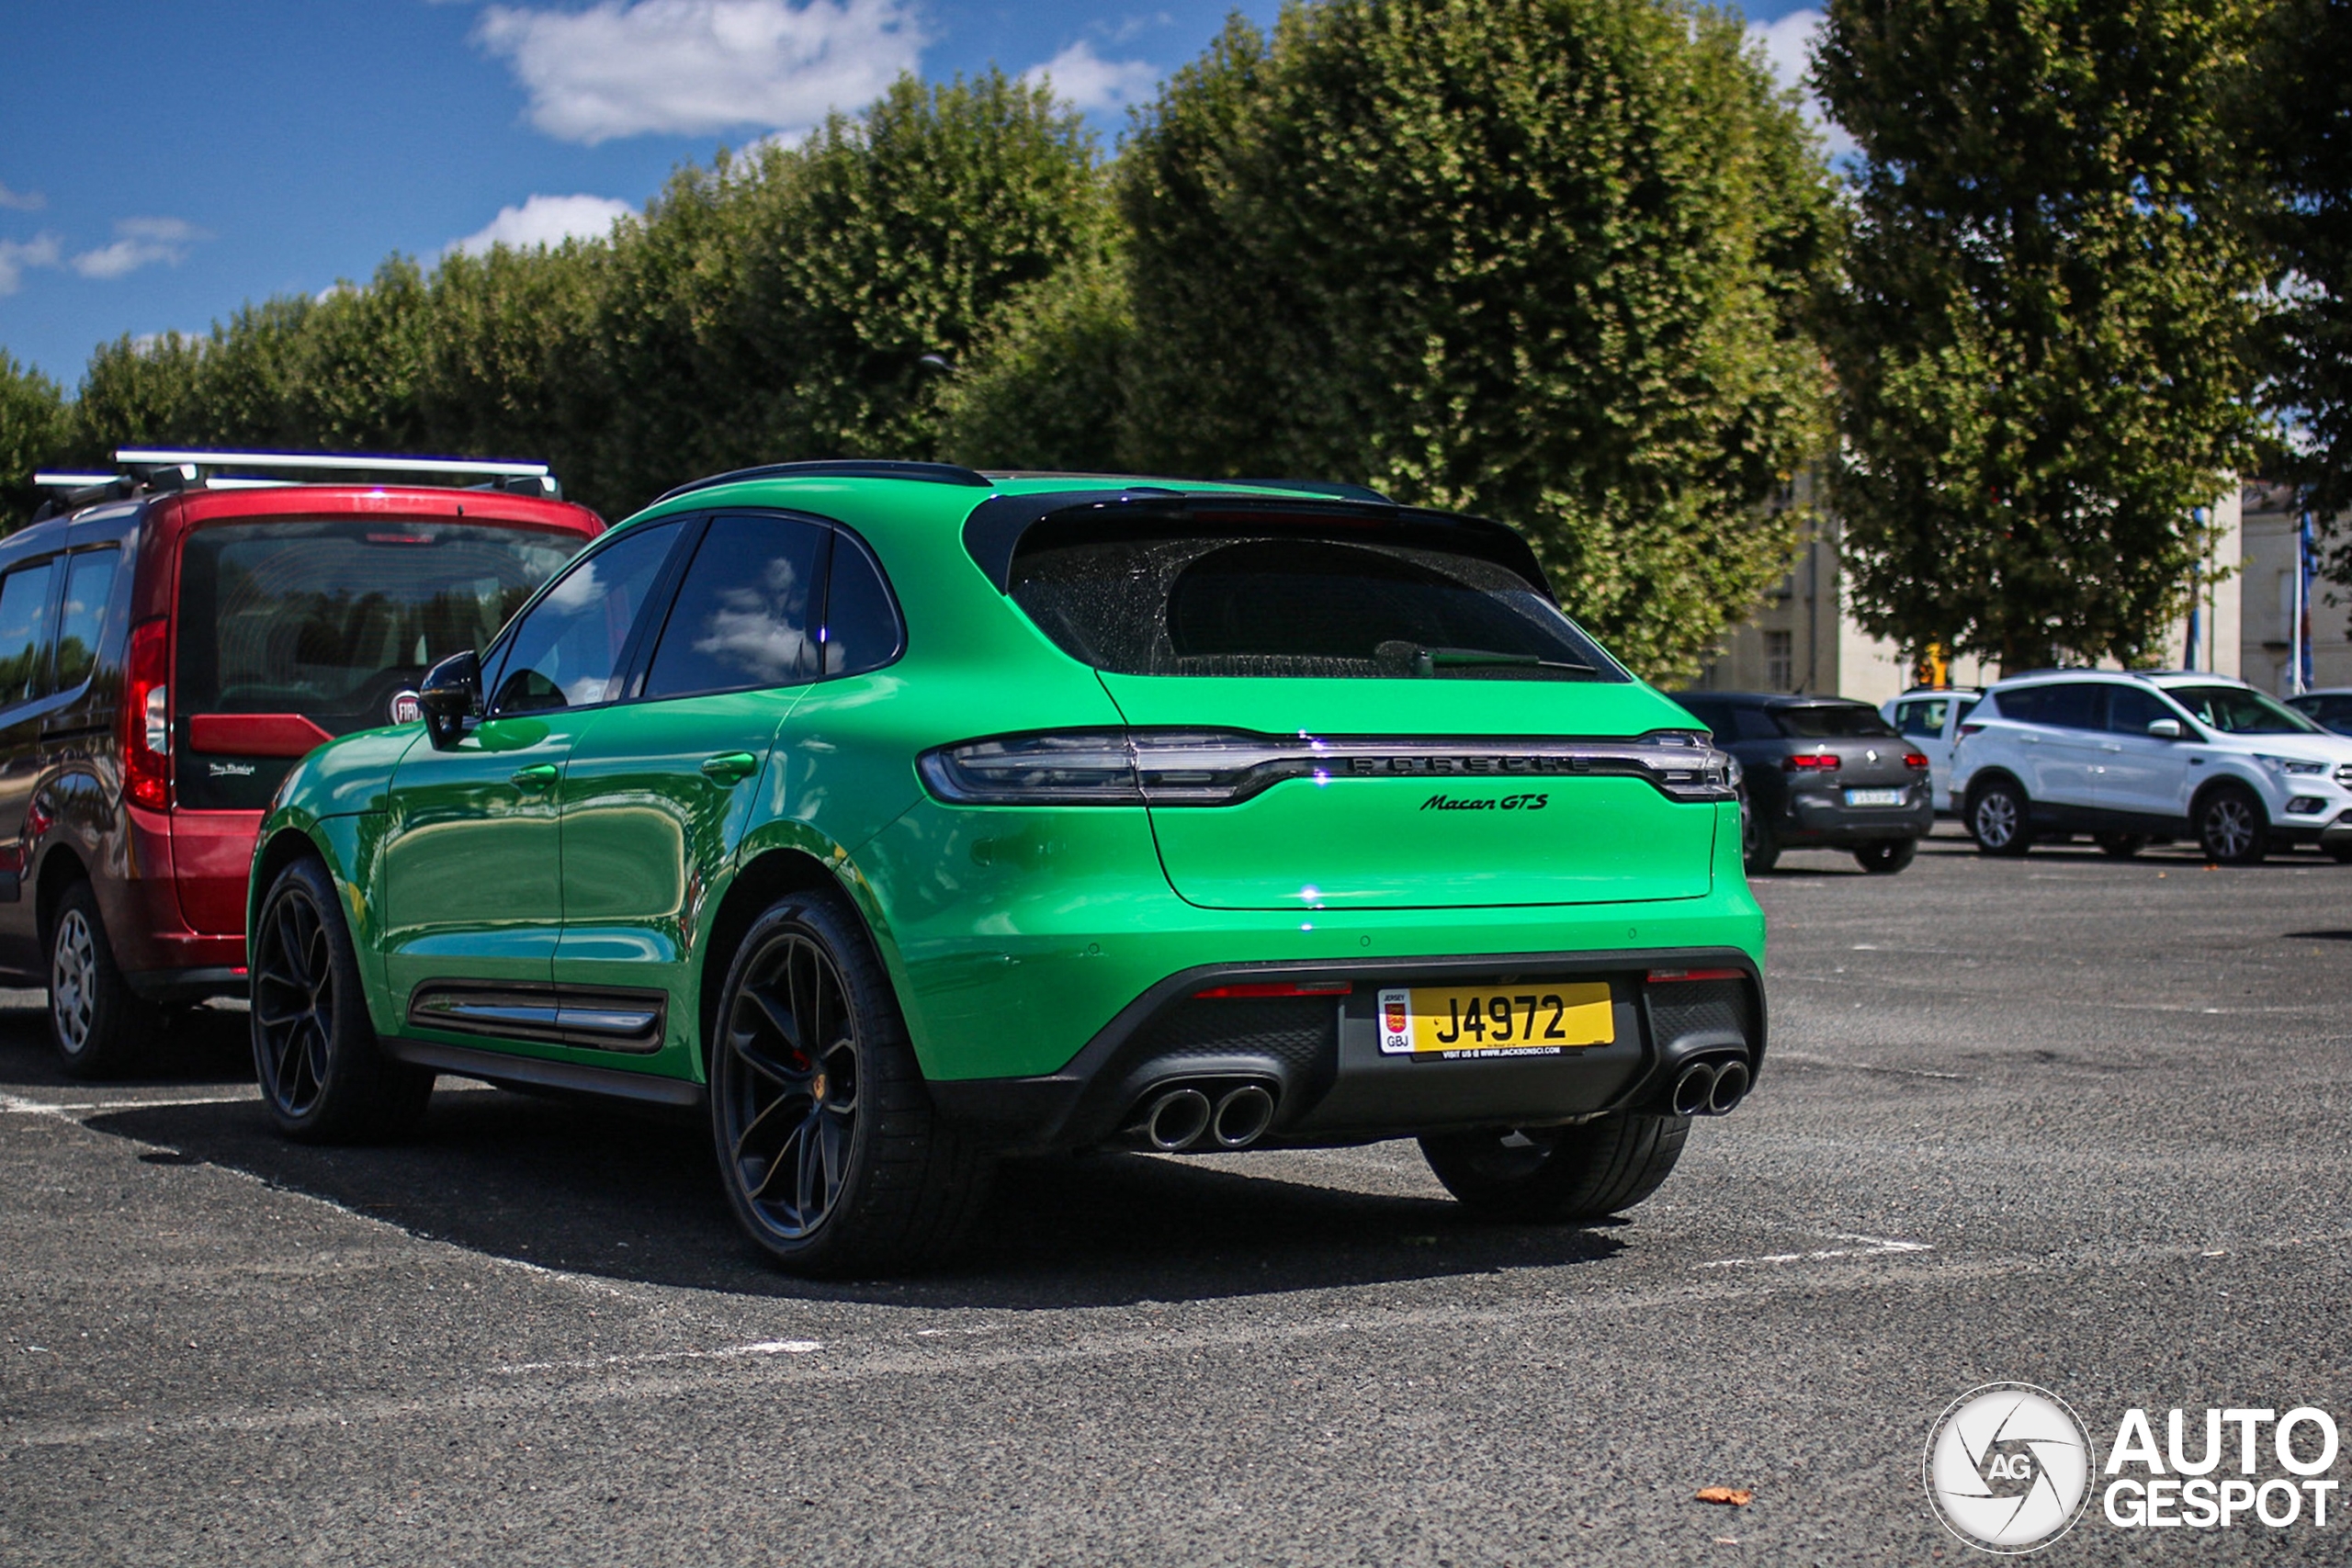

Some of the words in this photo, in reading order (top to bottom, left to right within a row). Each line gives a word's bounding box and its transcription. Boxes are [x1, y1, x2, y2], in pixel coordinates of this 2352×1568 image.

[1353, 757, 1591, 772] PORSCHE
[1419, 795, 1496, 810] Macan
[1500, 794, 1549, 810] GTS
[1384, 994, 1405, 1002] JERSEY
[1436, 995, 1566, 1043] J4972
[1386, 1035, 1408, 1047] GBJ
[1442, 1050, 1461, 1059] VISIT
[1462, 1050, 1472, 1058] US
